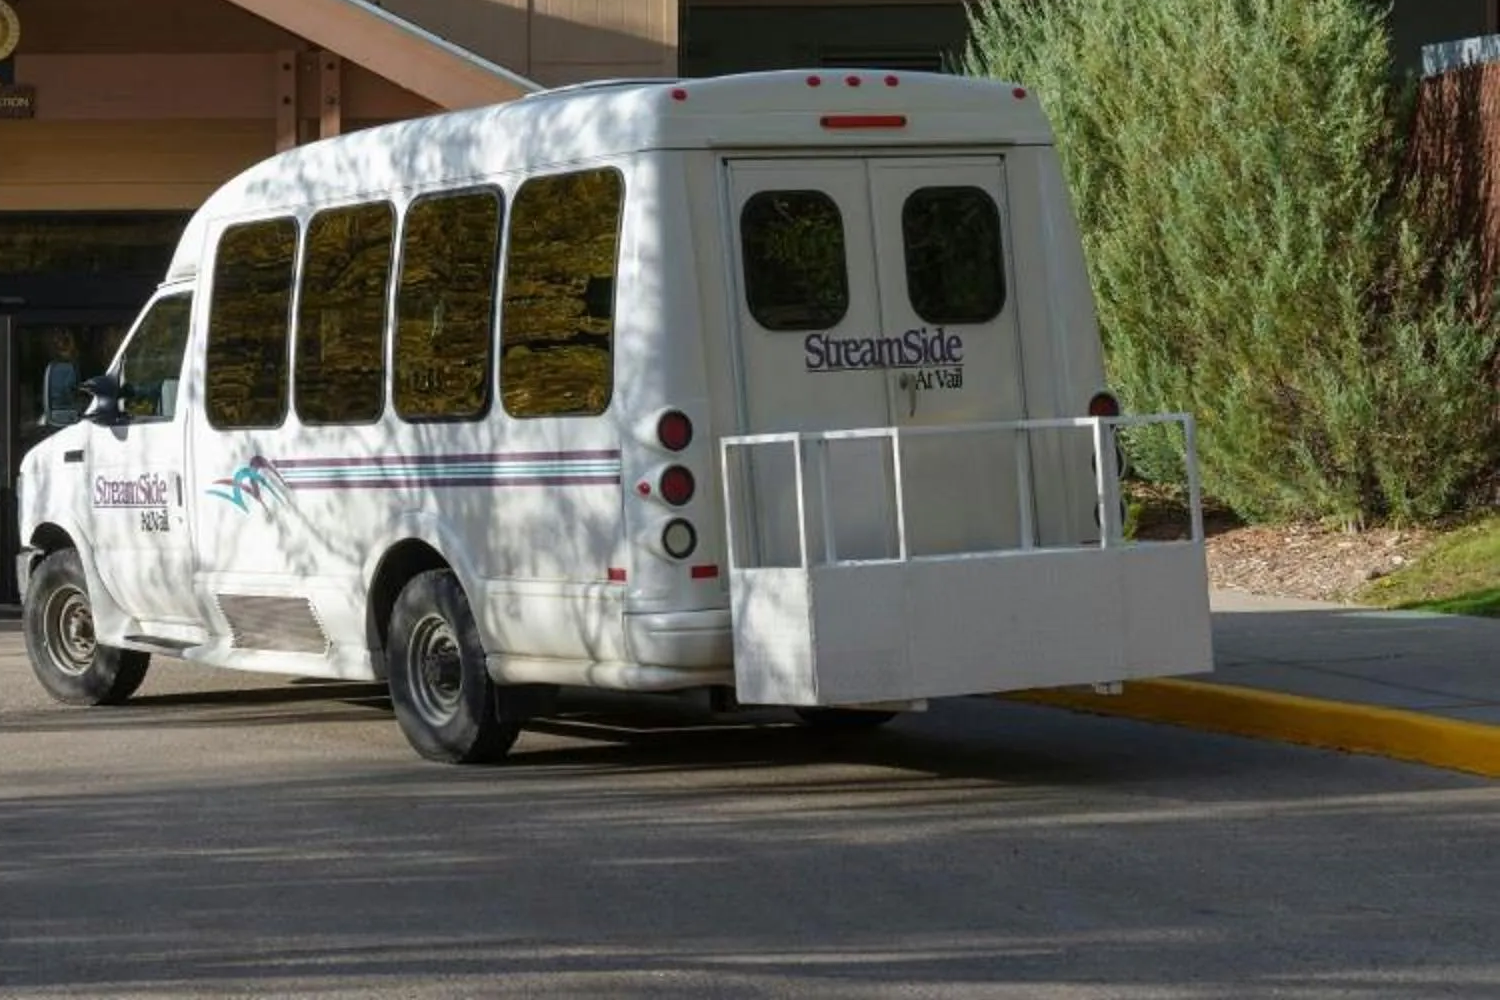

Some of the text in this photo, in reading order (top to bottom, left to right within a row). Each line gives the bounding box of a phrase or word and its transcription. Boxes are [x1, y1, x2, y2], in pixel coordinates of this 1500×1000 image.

[805, 327, 963, 369] StreamSide
[915, 367, 963, 390] At Vail
[94, 472, 167, 505] StreamSide
